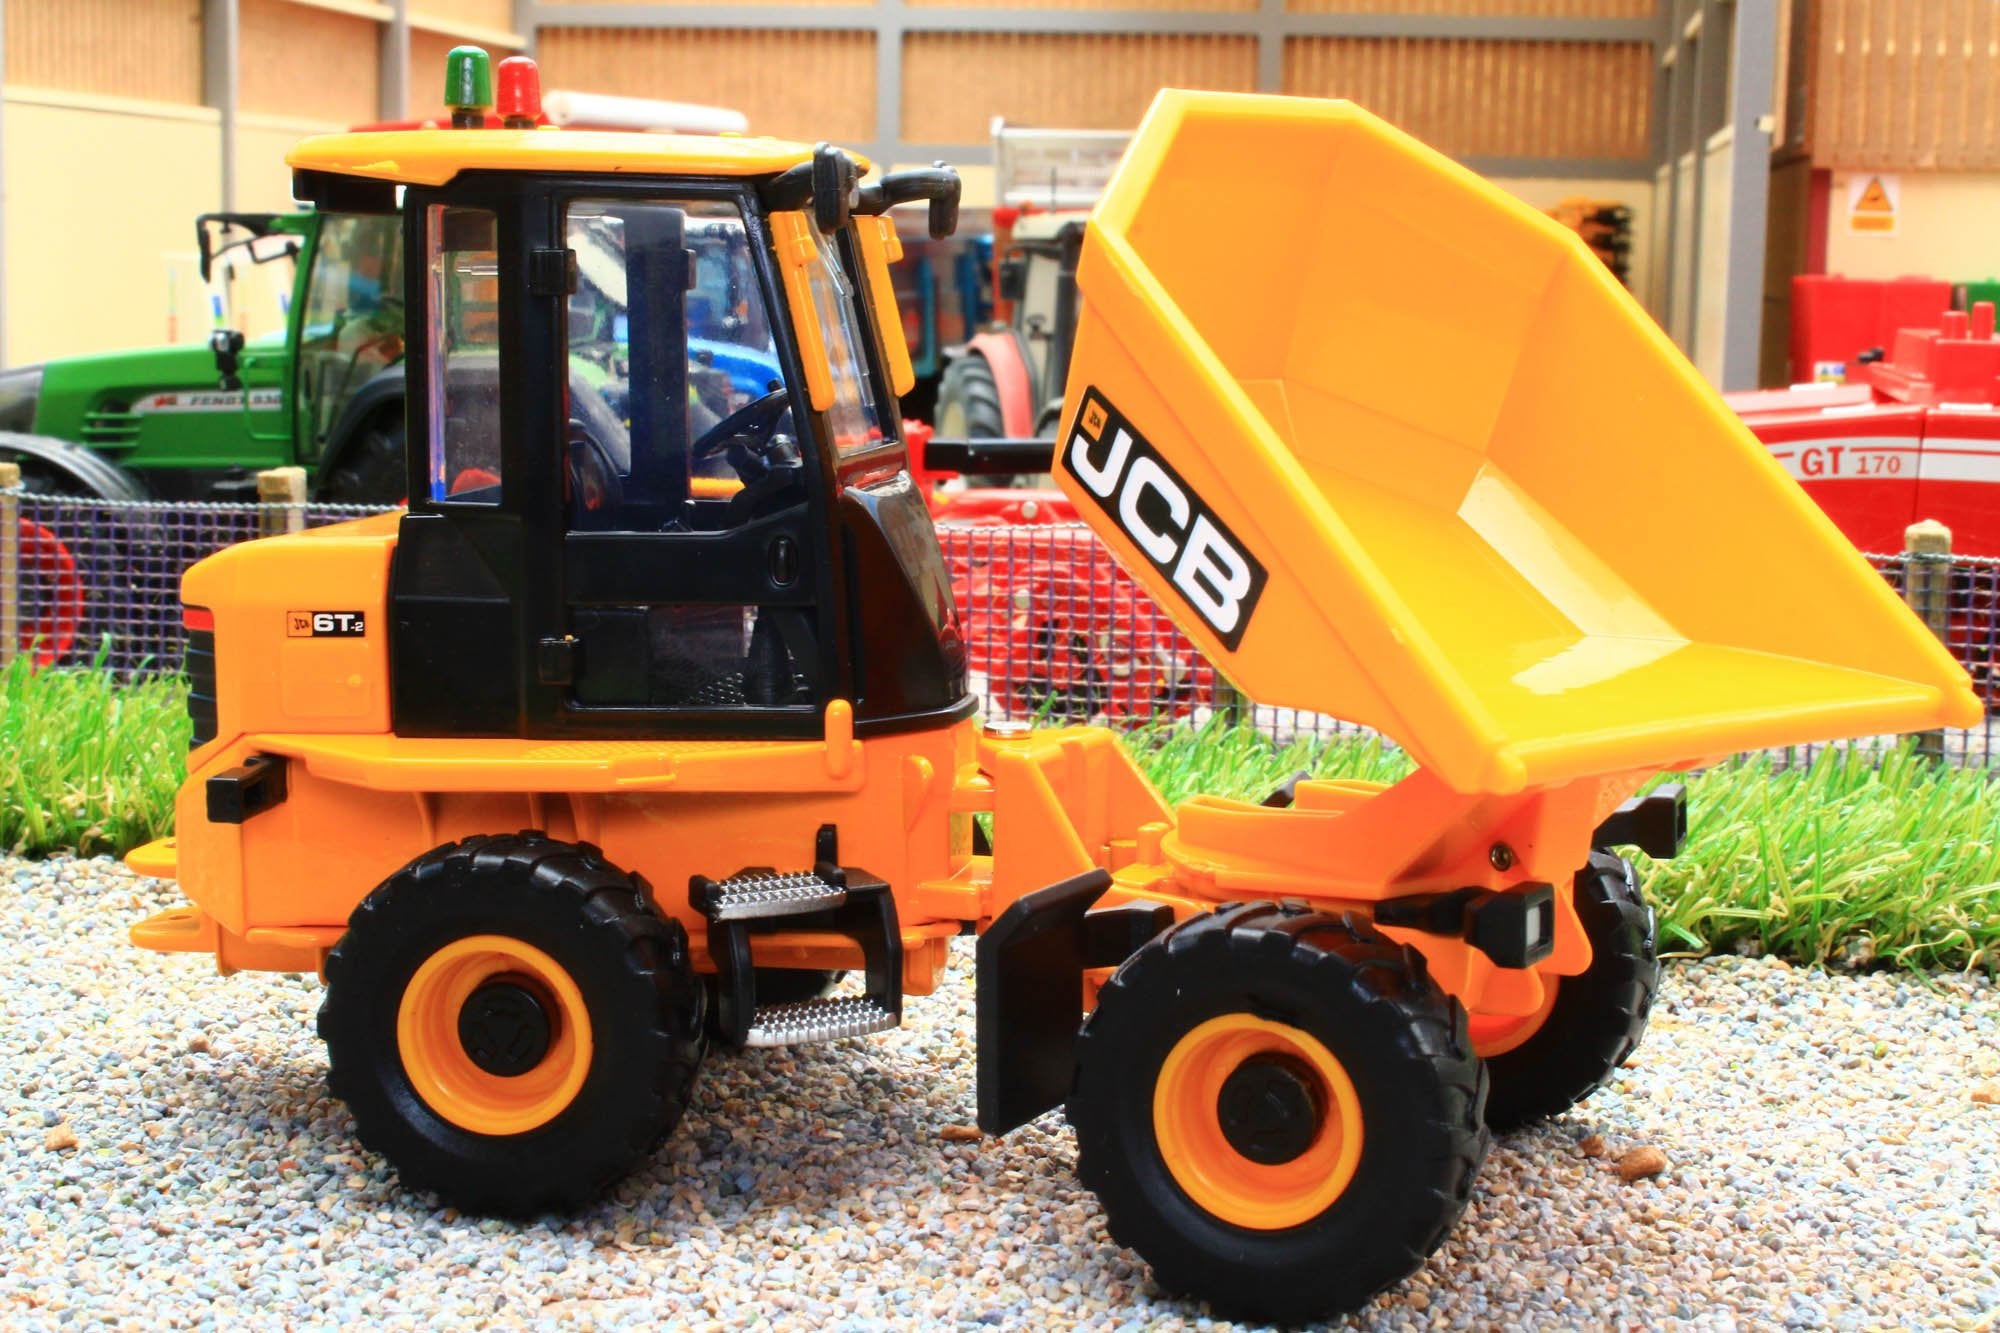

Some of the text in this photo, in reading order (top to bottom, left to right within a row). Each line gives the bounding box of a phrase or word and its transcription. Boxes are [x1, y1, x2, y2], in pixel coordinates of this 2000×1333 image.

[1801, 446, 1901, 476] GT 170
[1071, 428, 1251, 632] JCB
[313, 613, 364, 632] 6T-2
